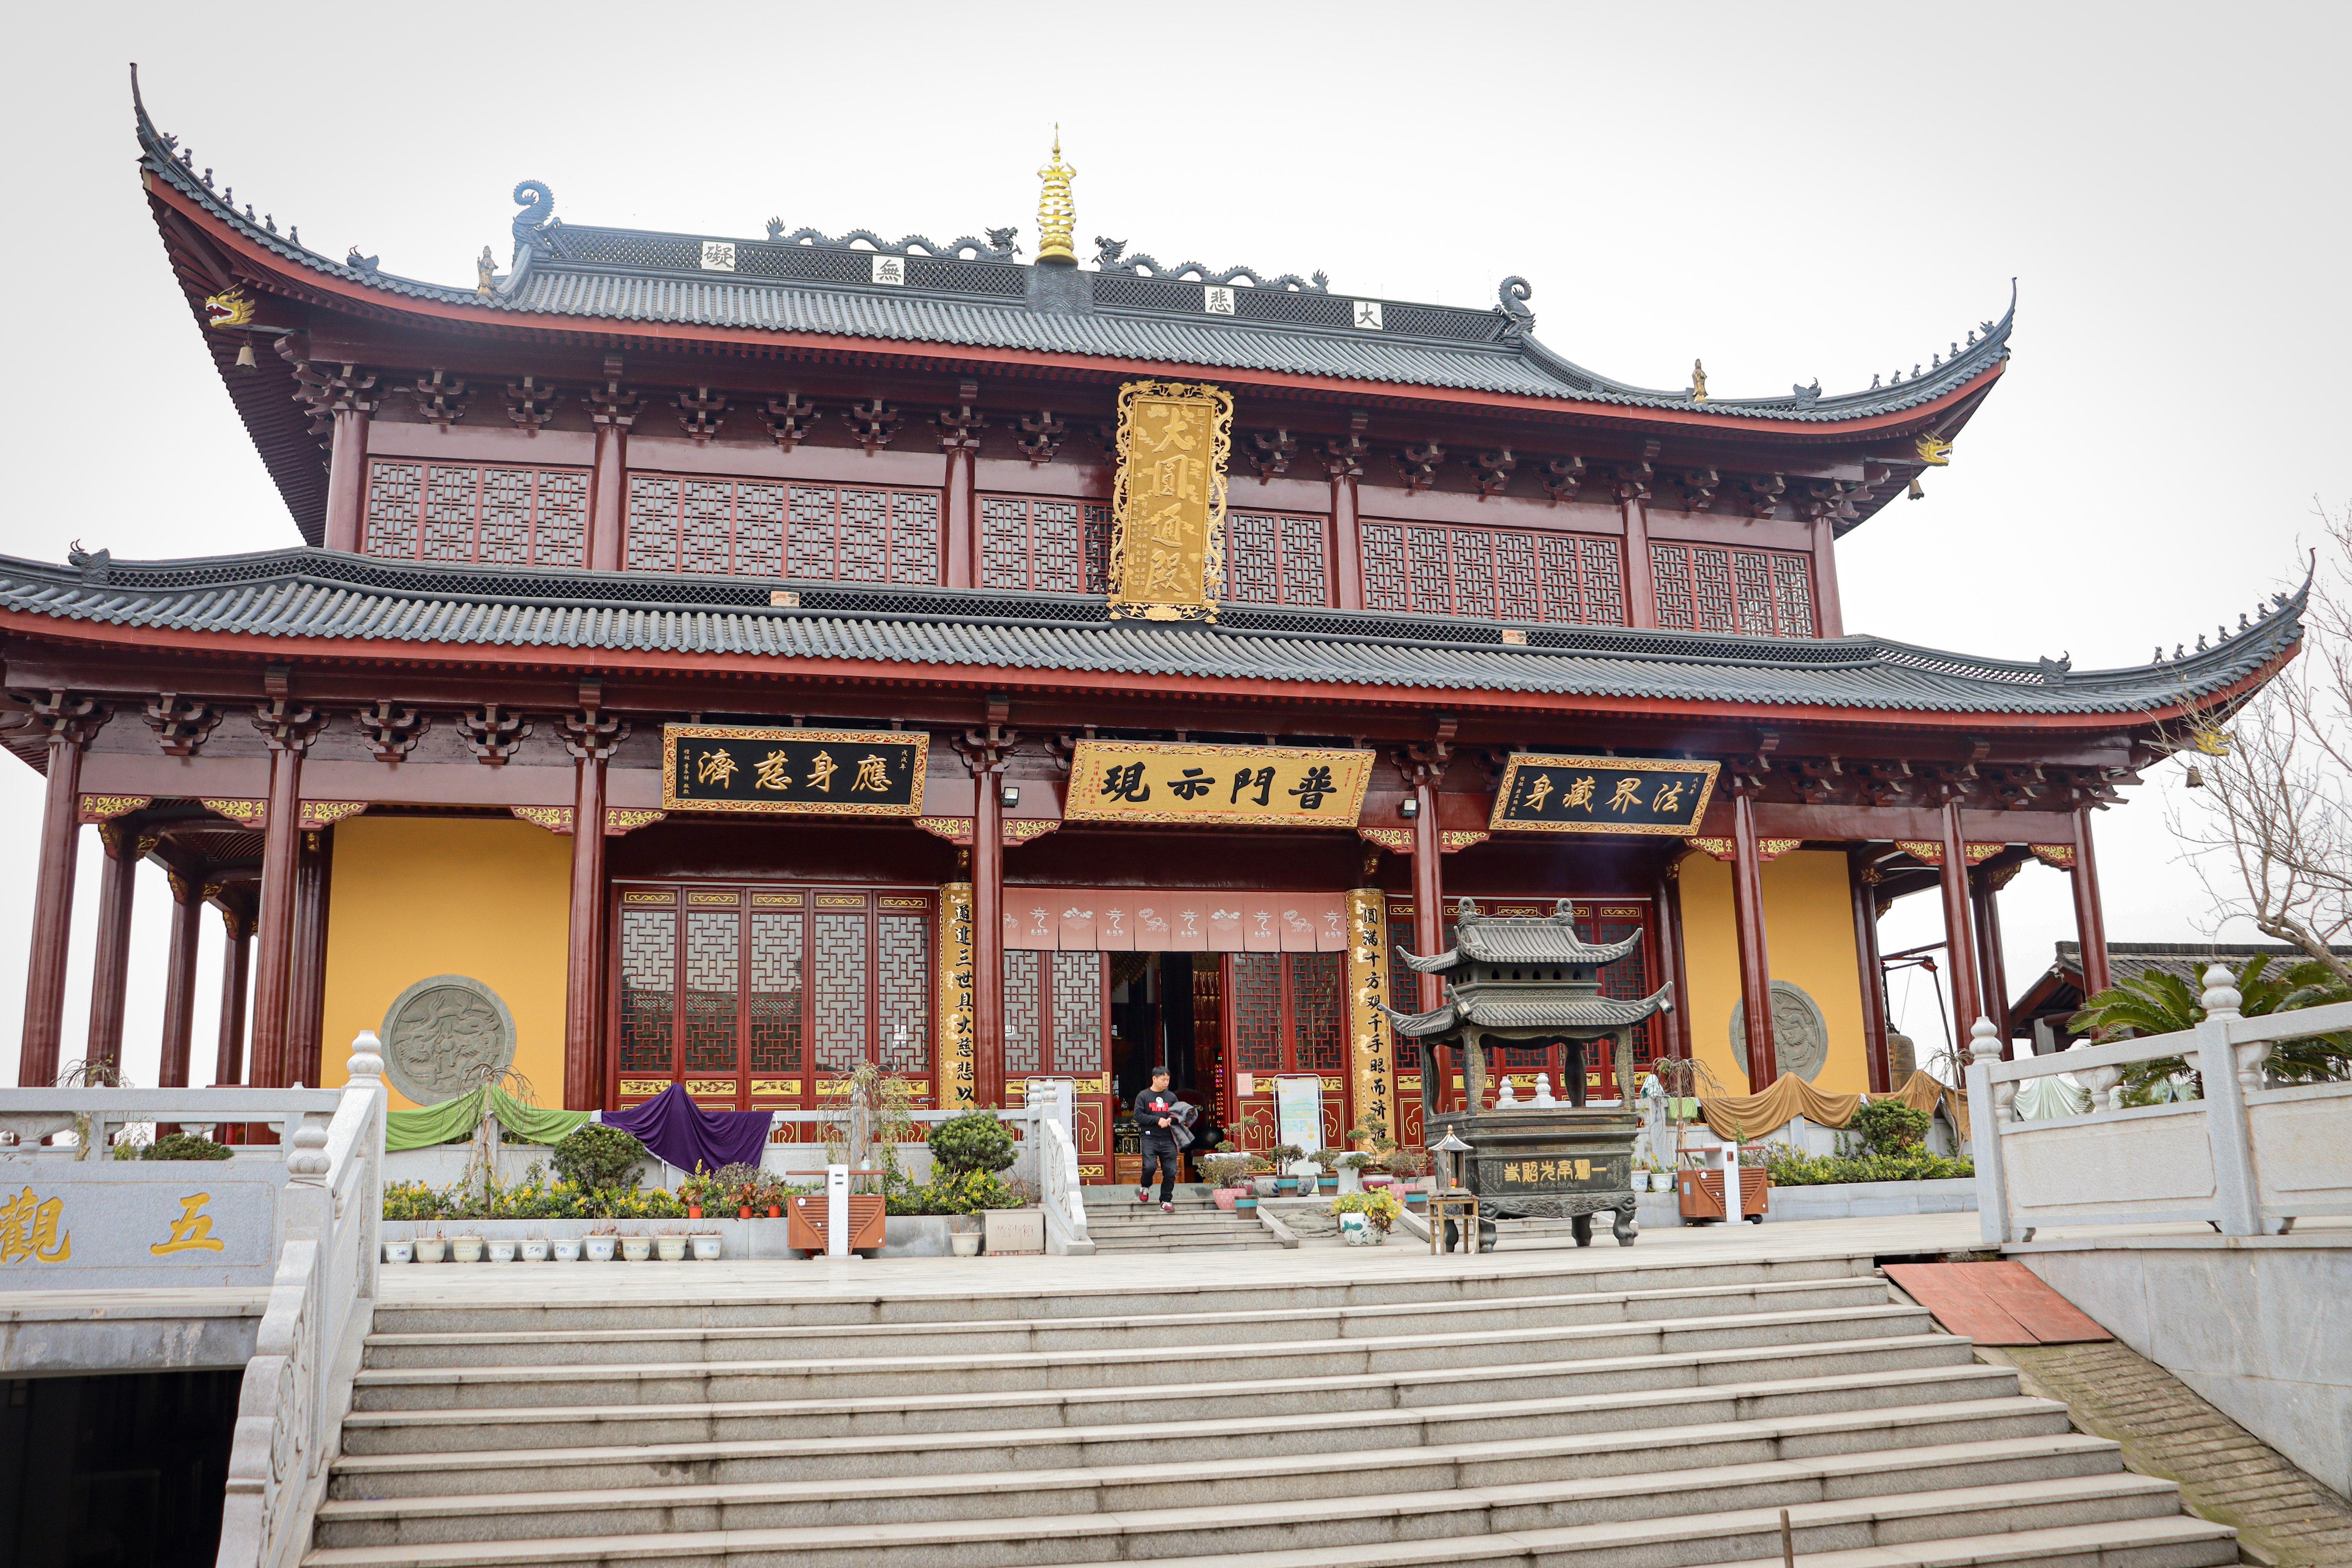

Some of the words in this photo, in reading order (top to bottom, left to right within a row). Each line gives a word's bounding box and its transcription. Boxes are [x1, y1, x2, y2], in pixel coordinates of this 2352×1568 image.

[704, 243, 735, 269] 礙
[877, 258, 902, 281] 無
[1209, 289, 1231, 312] 悲
[1356, 303, 1380, 327] 大
[1144, 407, 1192, 597] 大圓通殿
[698, 748, 893, 793] 應身慈濟
[899, 749, 908, 770] 戊戌年
[1101, 761, 1337, 809] 普門示現
[1523, 773, 1684, 814] 法界藏身
